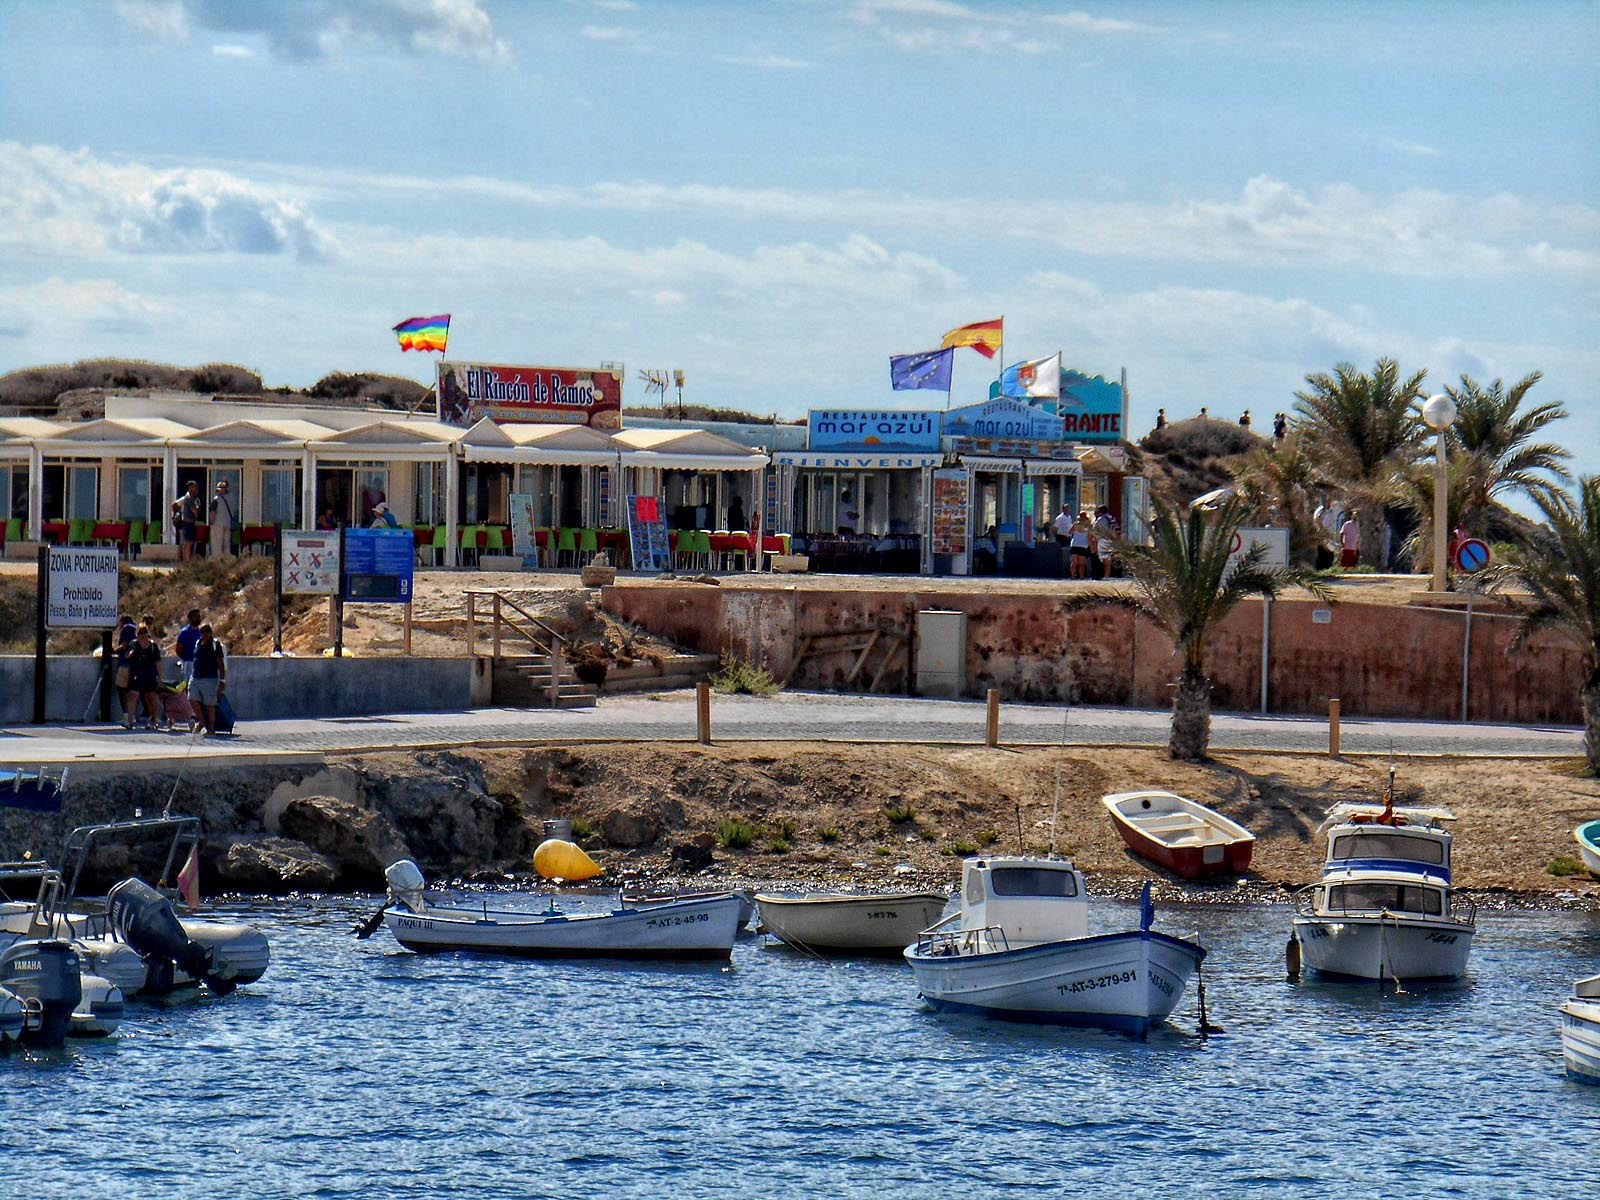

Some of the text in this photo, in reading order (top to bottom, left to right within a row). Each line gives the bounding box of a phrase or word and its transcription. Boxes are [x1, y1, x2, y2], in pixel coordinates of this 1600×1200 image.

[466, 370, 593, 405] El Rincón de Ramos
[823, 412, 927, 420] RESTAURANTE
[817, 419, 932, 434] mar azul
[974, 419, 1001, 435] mar
[1005, 416, 1034, 437] azul
[50, 554, 117, 573] ZONA PORTUARIA
[63, 587, 103, 600] Prohibido
[69, 604, 82, 617] Baño
[84, 608, 88, 620] y
[89, 604, 116, 618] Publicidad
[398, 918, 433, 929] PAQUI III
[14, 960, 42, 971] YAMAHA
